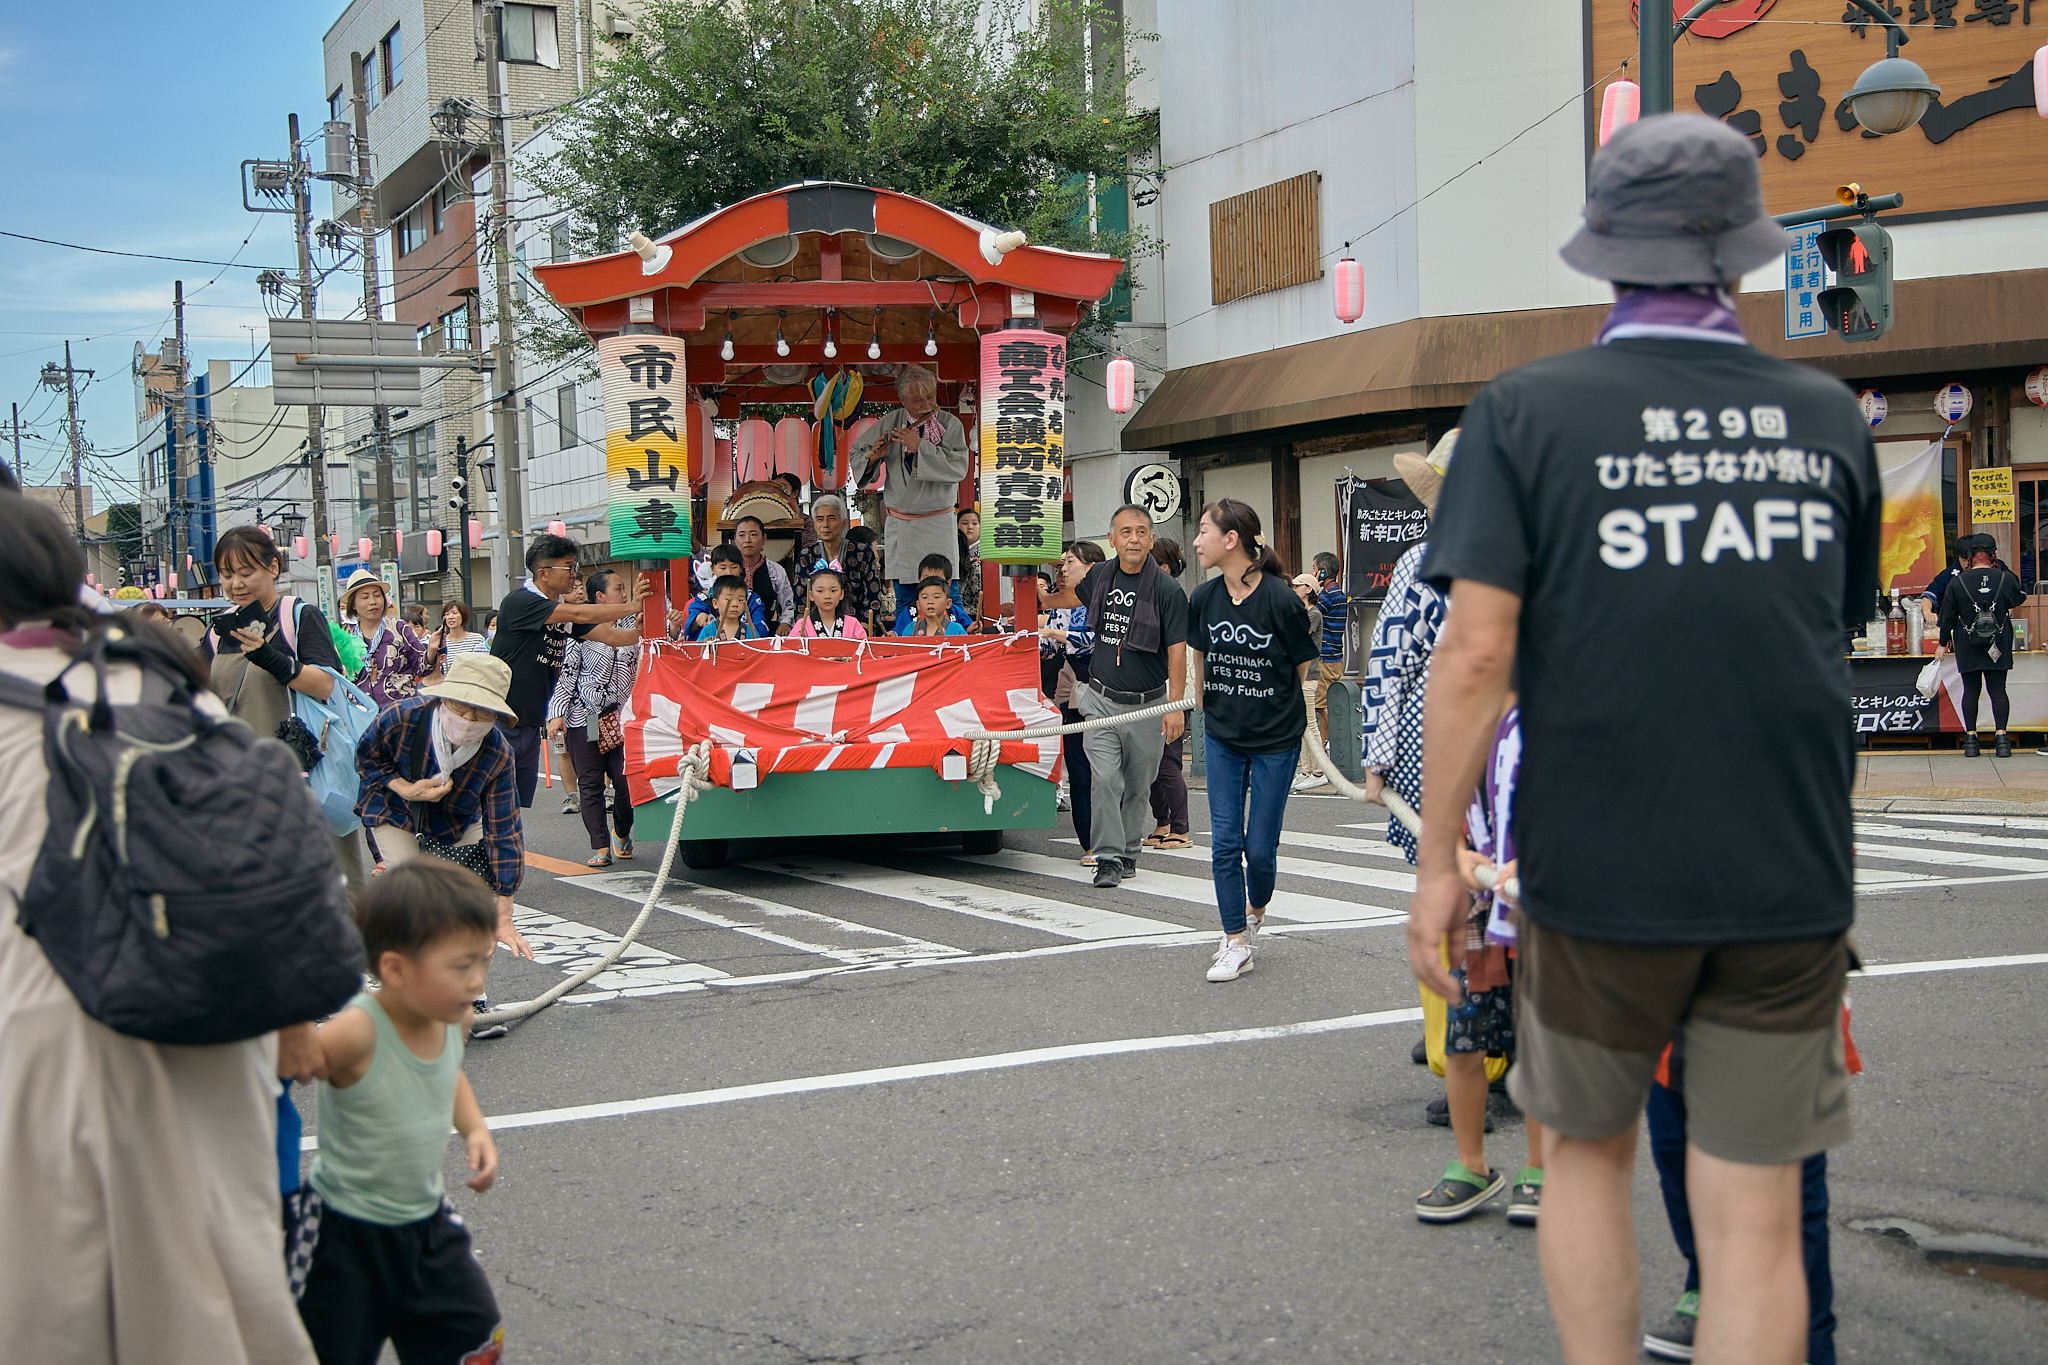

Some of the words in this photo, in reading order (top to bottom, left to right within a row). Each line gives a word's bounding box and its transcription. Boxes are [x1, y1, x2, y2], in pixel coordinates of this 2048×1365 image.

[1790, 235, 1804, 290] 自転車
[1806, 231, 1820, 288] 歩行者
[1799, 291, 1813, 328] 専用
[1047, 344, 1065, 500] ひたちなか
[1641, 405, 1789, 442] 第29回
[619, 344, 683, 543] 市民山車
[994, 341, 1049, 548] 商工会議所青年部
[1595, 446, 1833, 490] ひたちなか祭り
[1973, 509, 2012, 519] メンチカツ
[1597, 499, 1835, 571] STAFF
[1379, 562, 1397, 571] SUP
[1105, 622, 1120, 632] FES
[1206, 651, 1273, 668] ITACHINAKA
[1213, 666, 1232, 678] FES
[1234, 669, 1262, 682] 2023
[1203, 680, 1235, 695] Happy
[1237, 684, 1274, 698] Future
[1852, 709, 1924, 733] 口〈生〉
